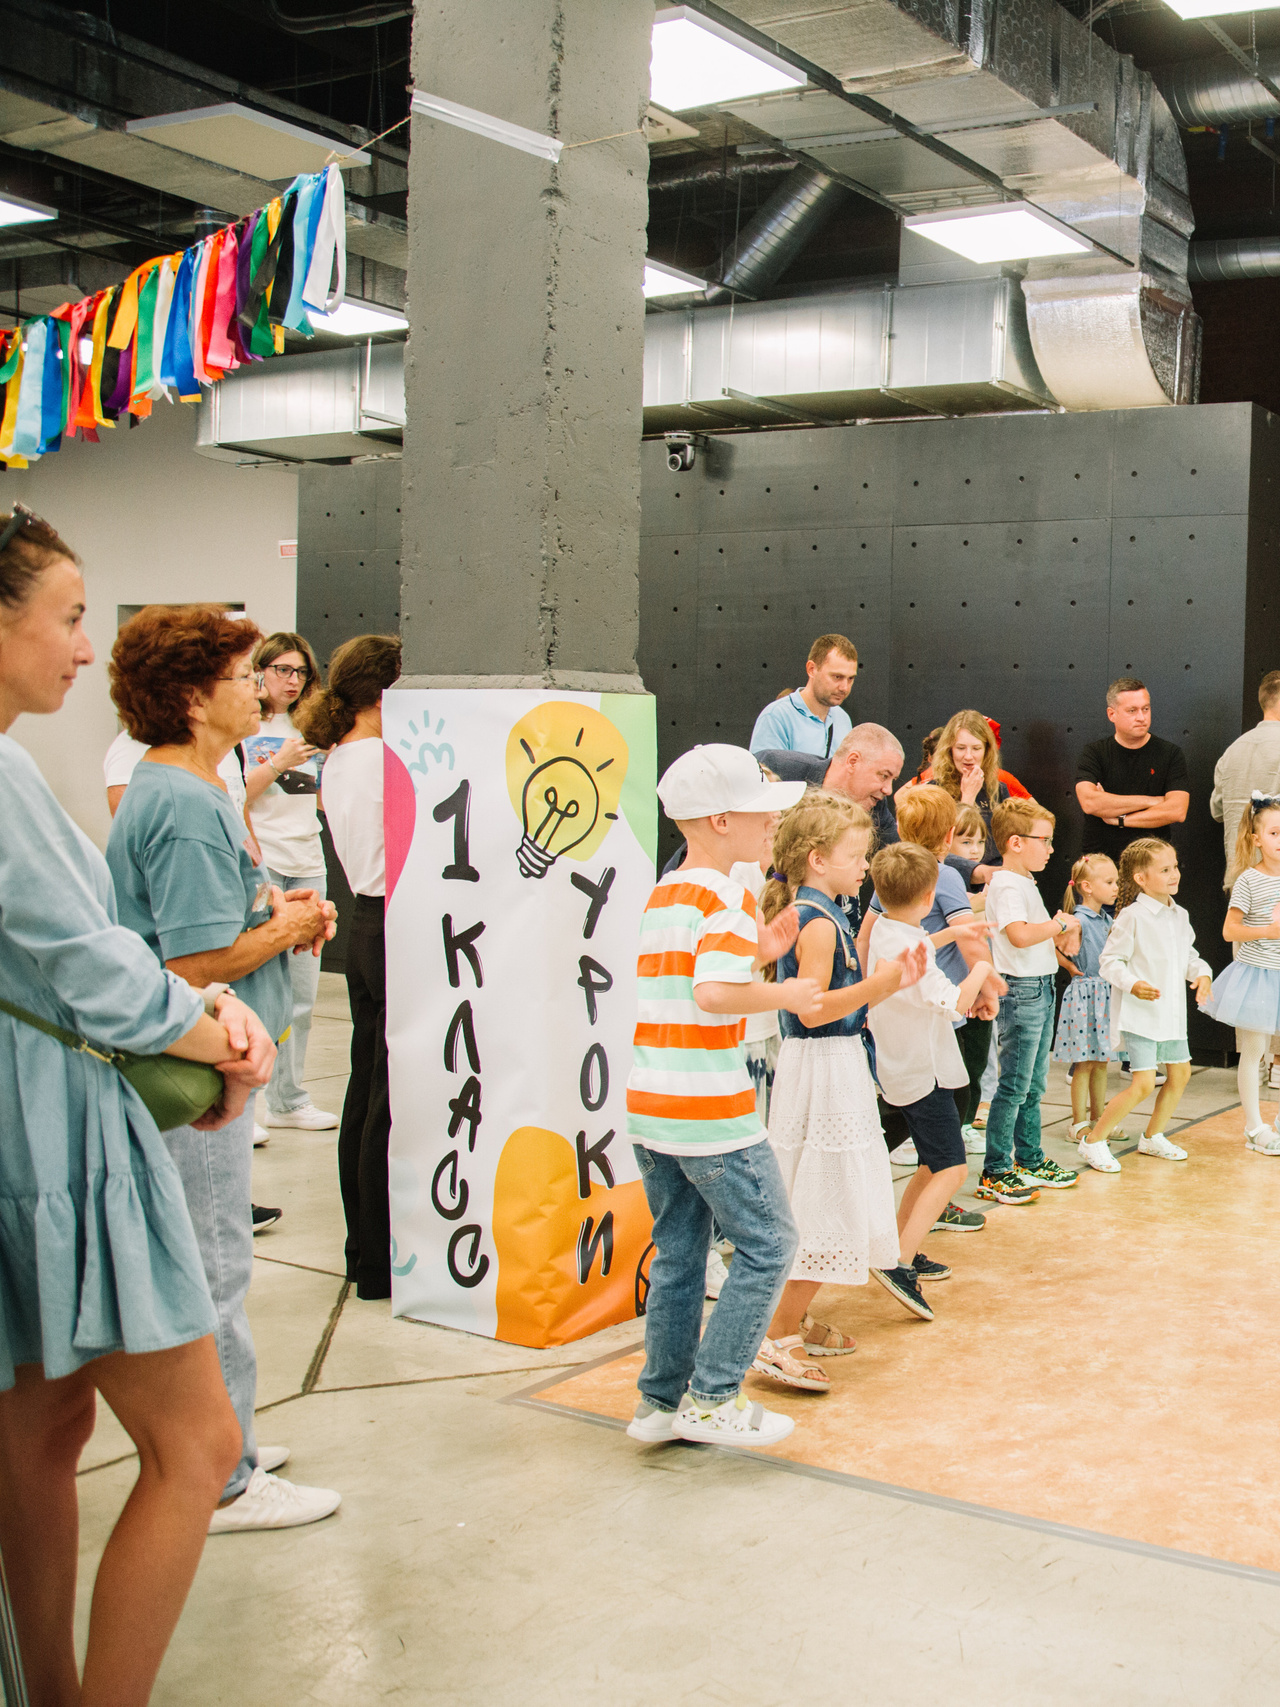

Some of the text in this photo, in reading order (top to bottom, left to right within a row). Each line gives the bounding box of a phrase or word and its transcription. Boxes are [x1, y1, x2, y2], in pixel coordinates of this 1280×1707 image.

[432, 779, 490, 1289] 1 КЛАСС
[571, 867, 616, 1285] УРОКИ
